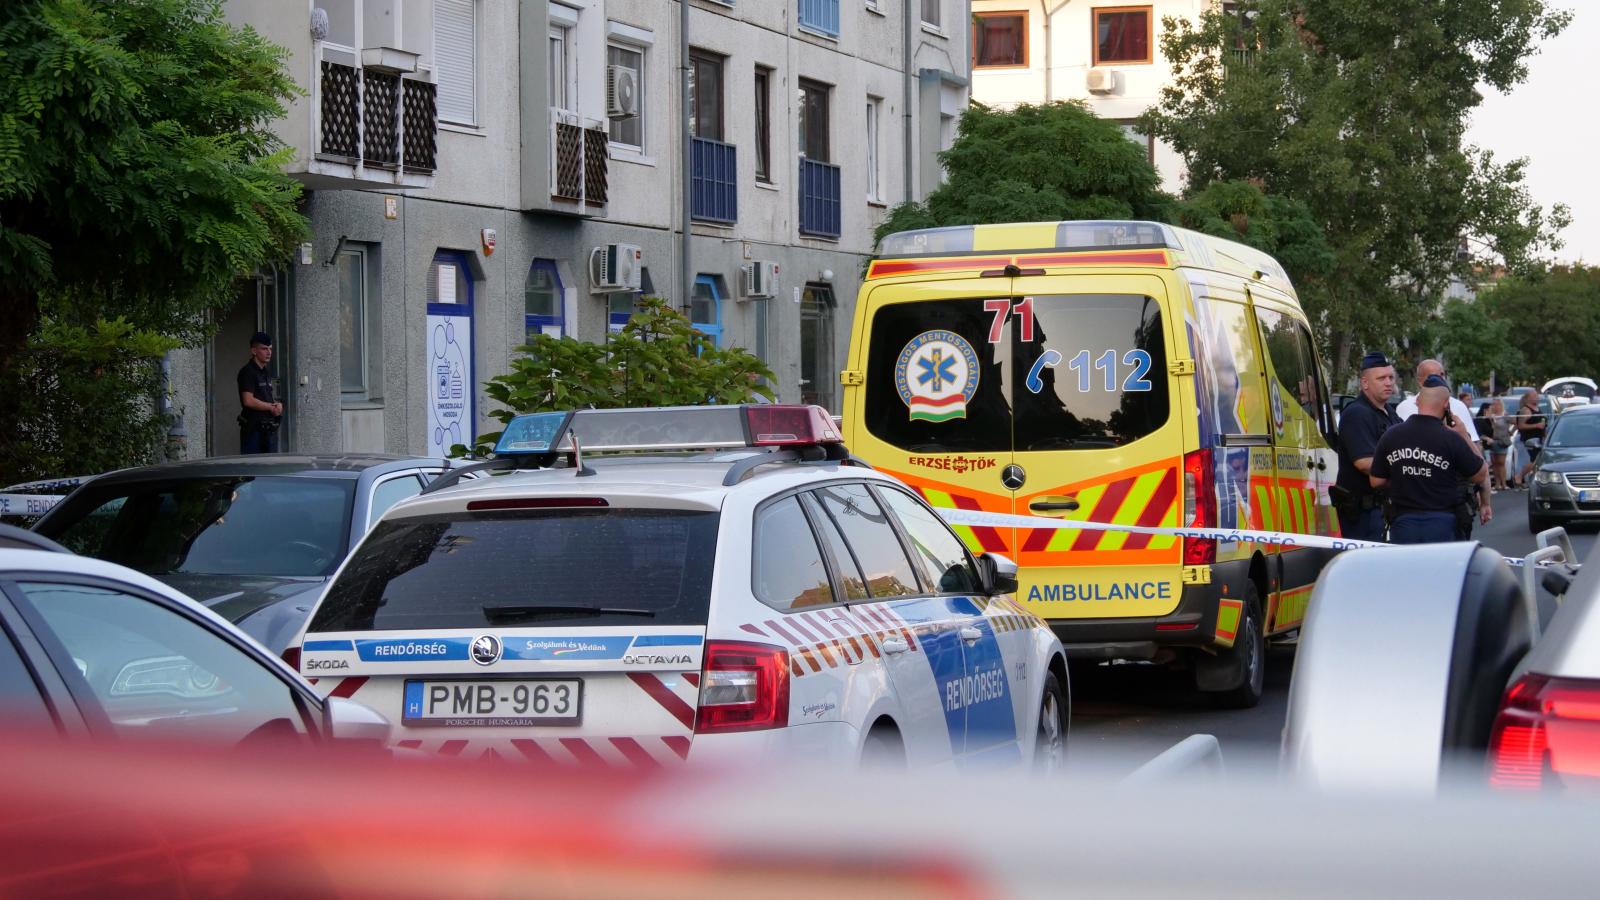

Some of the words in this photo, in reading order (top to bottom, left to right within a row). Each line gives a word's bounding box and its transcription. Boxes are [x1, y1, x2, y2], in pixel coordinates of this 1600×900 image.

[984, 297, 1034, 343] 71
[897, 343, 917, 398] ORSZÁGOS
[1069, 349, 1152, 392] 112
[1386, 446, 1450, 470] RENDŐRSÉG
[1402, 465, 1432, 477] POLICE
[1027, 581, 1171, 602] AMBULANCE
[375, 642, 447, 656] RENDŐRSÉG
[623, 654, 692, 665] OCTAVIA
[946, 661, 1003, 712] RENDŐRSÉG
[410, 703, 418, 713] H
[429, 684, 570, 714] PMB-963
